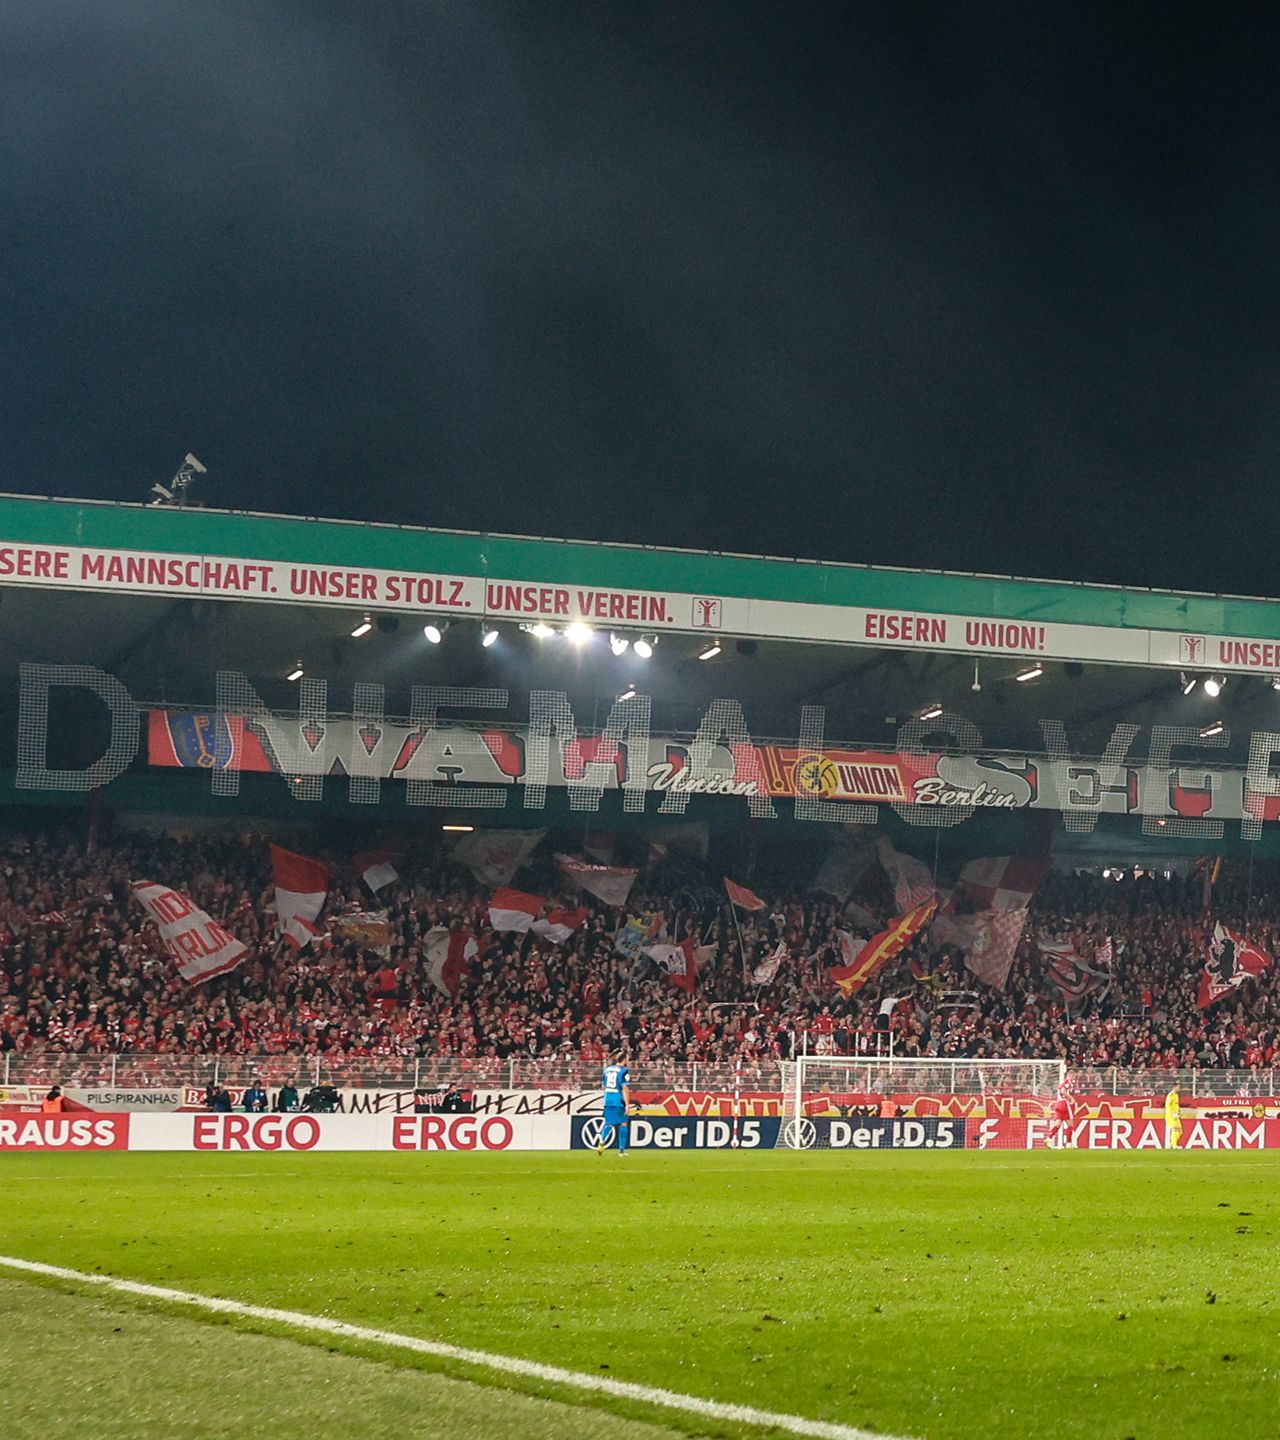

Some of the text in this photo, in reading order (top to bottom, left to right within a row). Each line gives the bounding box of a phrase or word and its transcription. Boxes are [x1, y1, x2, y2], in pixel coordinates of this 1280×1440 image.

[81, 553, 278, 594] MANNSCHAFT.
[290, 568, 378, 602] UNSER
[385, 576, 471, 608] STOLZ.
[486, 585, 570, 616] UNSER
[578, 592, 674, 624] VEREIN.
[865, 613, 1046, 651] EISERN UNION!
[14, 663, 139, 792] D
[210, 670, 982, 827] NIEMALS
[646, 762, 1018, 808] Union Berlin
[837, 764, 905, 797] UNION
[606, 1071, 618, 1089] 19
[87, 1092, 179, 1105] PILS-PIRANHAS
[193, 1115, 321, 1150] ERGO
[392, 1115, 514, 1150] ERGO
[630, 1121, 690, 1147] Der
[830, 1122, 885, 1147] Der
[892, 1121, 955, 1148] ID.5
